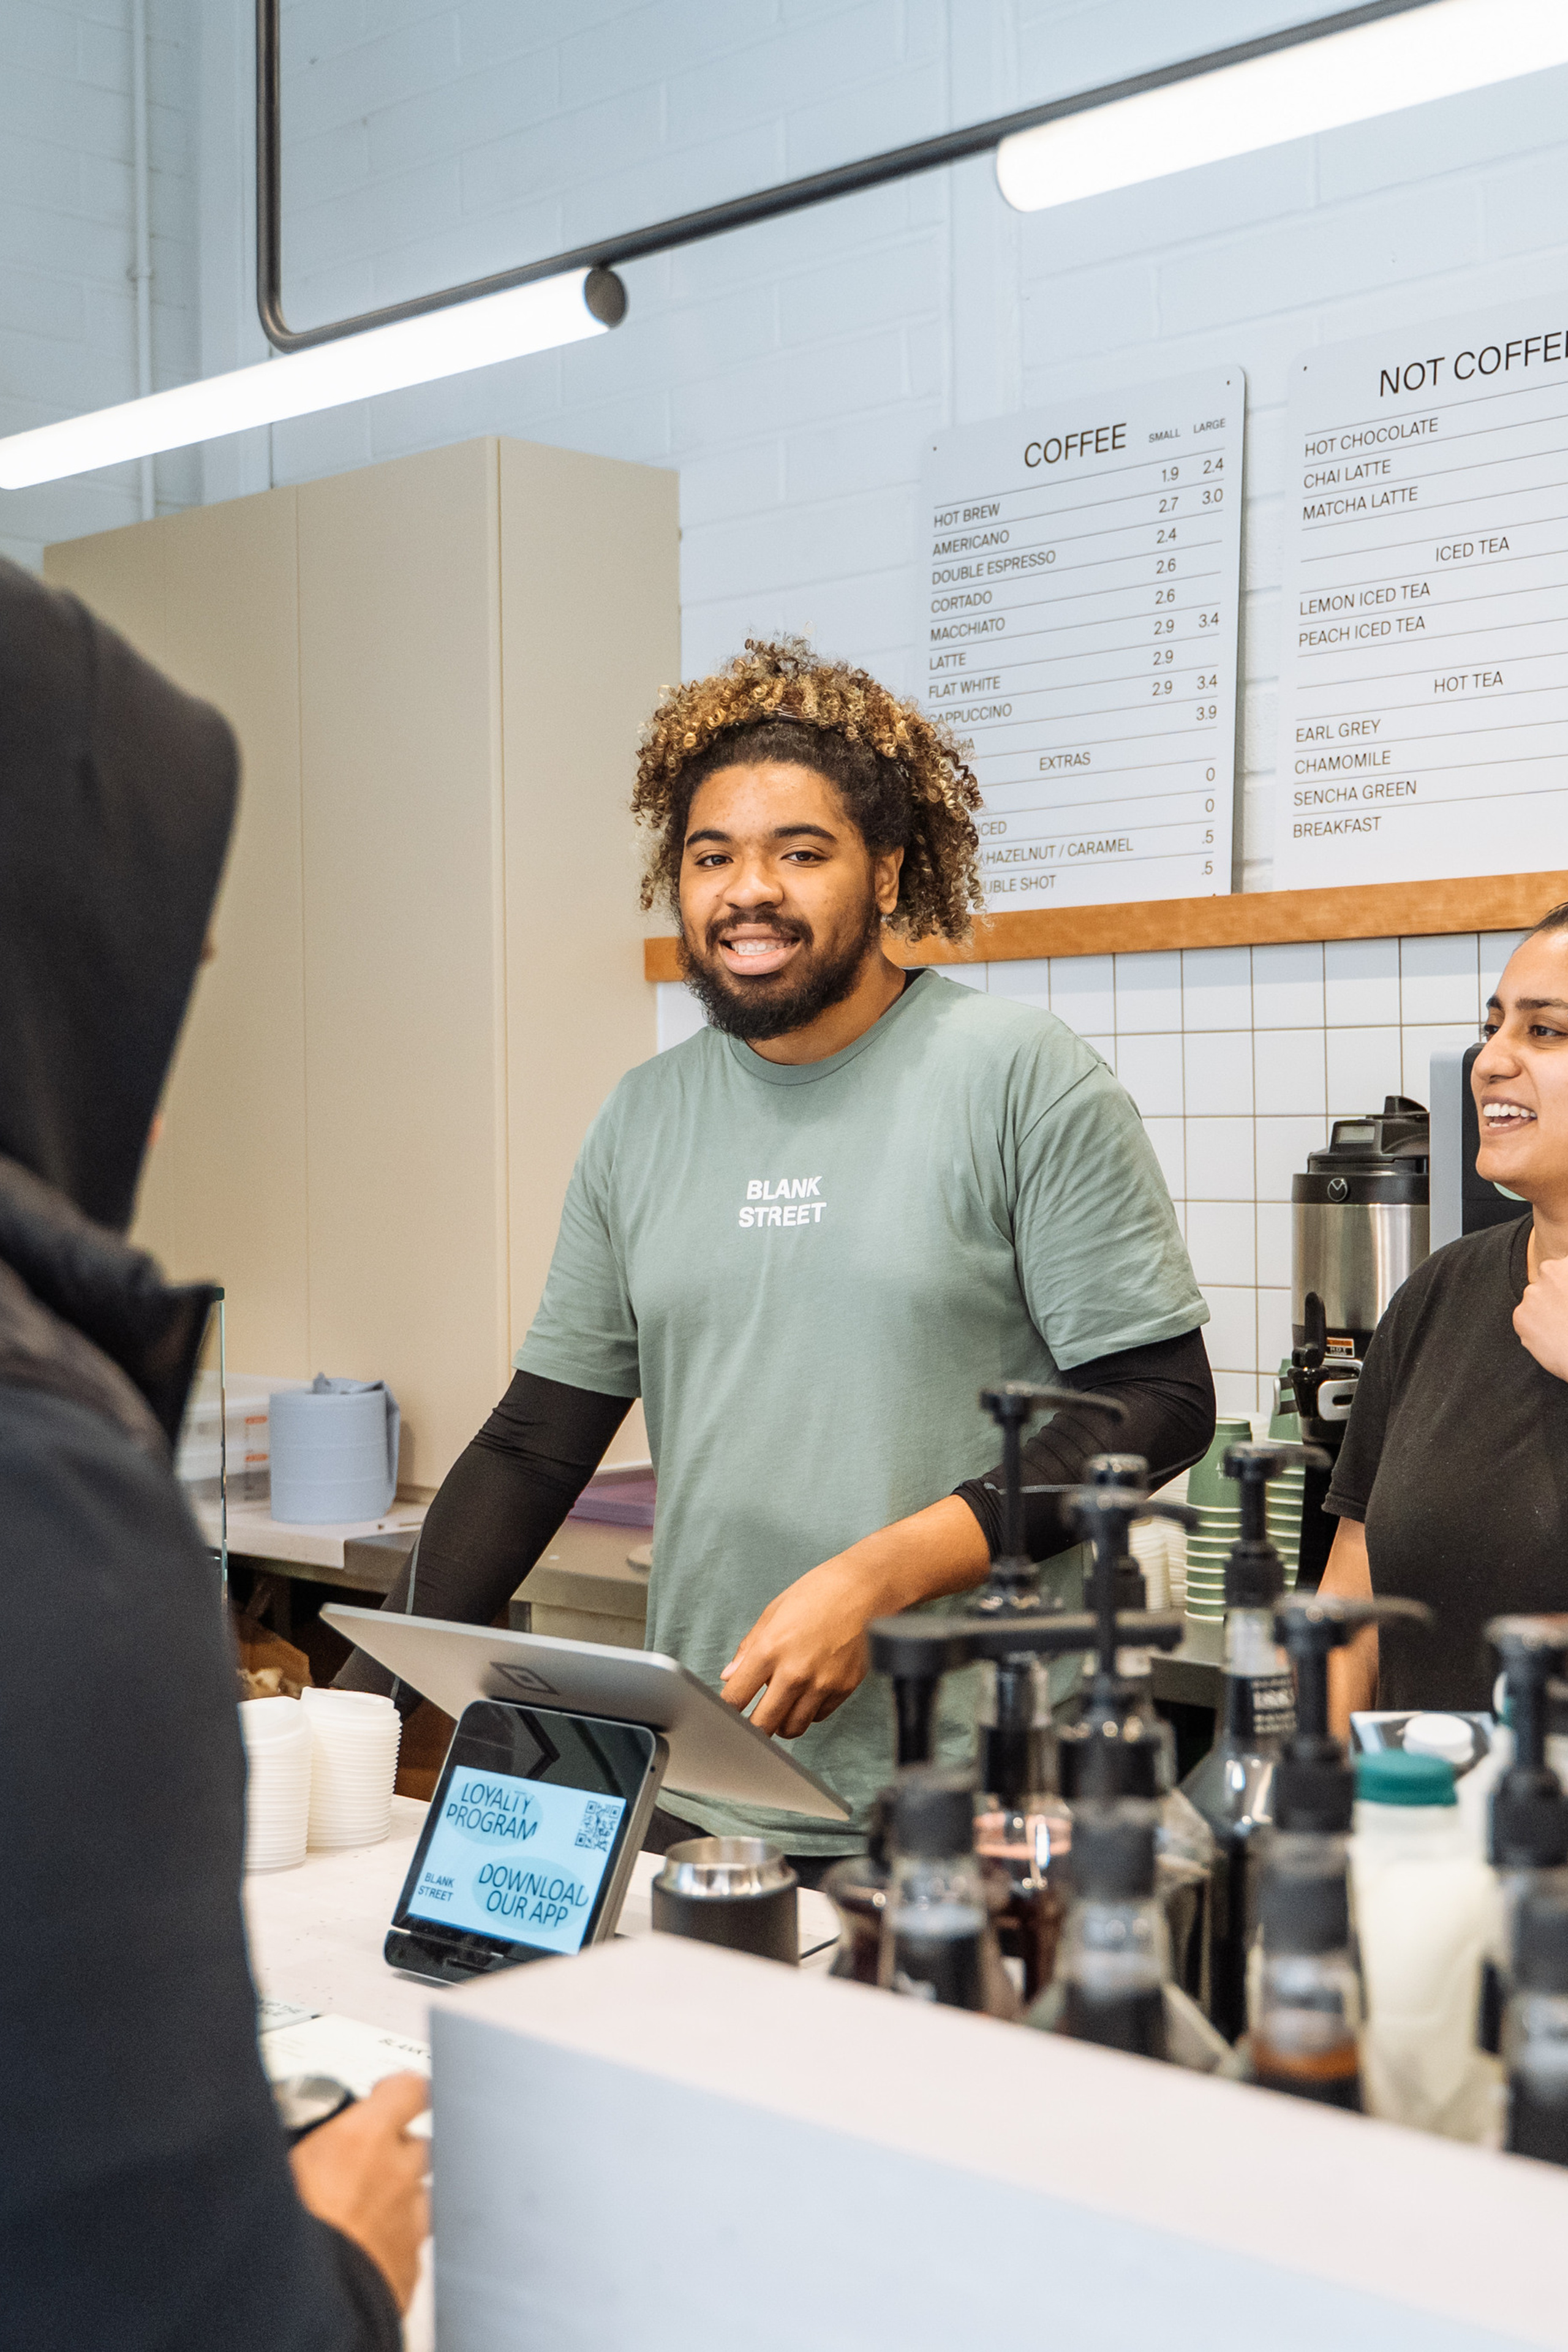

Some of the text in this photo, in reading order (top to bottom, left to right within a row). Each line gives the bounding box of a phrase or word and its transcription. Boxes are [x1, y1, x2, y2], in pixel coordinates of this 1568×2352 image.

[1380, 330, 1568, 397] NOT COFFE
[1024, 423, 1127, 469] COFFEE
[1148, 418, 1226, 443] SMALL LARGE
[1305, 417, 1439, 458] HOT CHOCOLATE
[1303, 459, 1391, 489] CHAI LATTE
[933, 458, 1224, 527] HOT BREW 1.9 2.4
[1303, 486, 1419, 521] MATCHA LATTE
[932, 488, 1223, 557] AMERICANO 2.7 3.0
[932, 528, 1177, 585] DOUBLE ESPRESSO 2.4
[1436, 537, 1510, 562] ICED TEA
[931, 559, 1177, 613] CORTADO 2.6
[1300, 582, 1431, 616] LEMON ICED TEA
[930, 589, 1175, 641] MACCHIATO 2.6
[929, 612, 1219, 670] LATTE 2.9 3.4
[1299, 616, 1426, 647] PEACH ICED TEA
[929, 650, 1174, 699] FLAT WHITE 2.9
[1434, 671, 1504, 694] HOT TEA
[928, 674, 1218, 723] CAPPUCCINO 2.9 3.4
[1196, 706, 1218, 721] 3.9
[1296, 718, 1381, 742] EARL GREY
[1039, 752, 1091, 771] EXTRAS
[1295, 750, 1392, 775] CHAMOMILE
[1294, 780, 1417, 807] SENCHA GREEN
[1293, 816, 1382, 839] BREAKFAST
[987, 845, 1056, 864] HAZELNUT
[1068, 838, 1134, 856] CARAMEL
[1202, 830, 1214, 845] .5
[1020, 875, 1056, 891] SHOT
[1201, 861, 1213, 876] .5
[747, 1176, 822, 1200] BLANK
[739, 1202, 827, 1227] STREET
[461, 1783, 535, 1814] LOYALTY
[447, 1803, 537, 1840] PROGRAM
[418, 1885, 453, 1902] STREET
[424, 1872, 455, 1888] BLANK
[479, 1863, 589, 1906] DOWNLOAD
[487, 1890, 568, 1928] OUR APP
